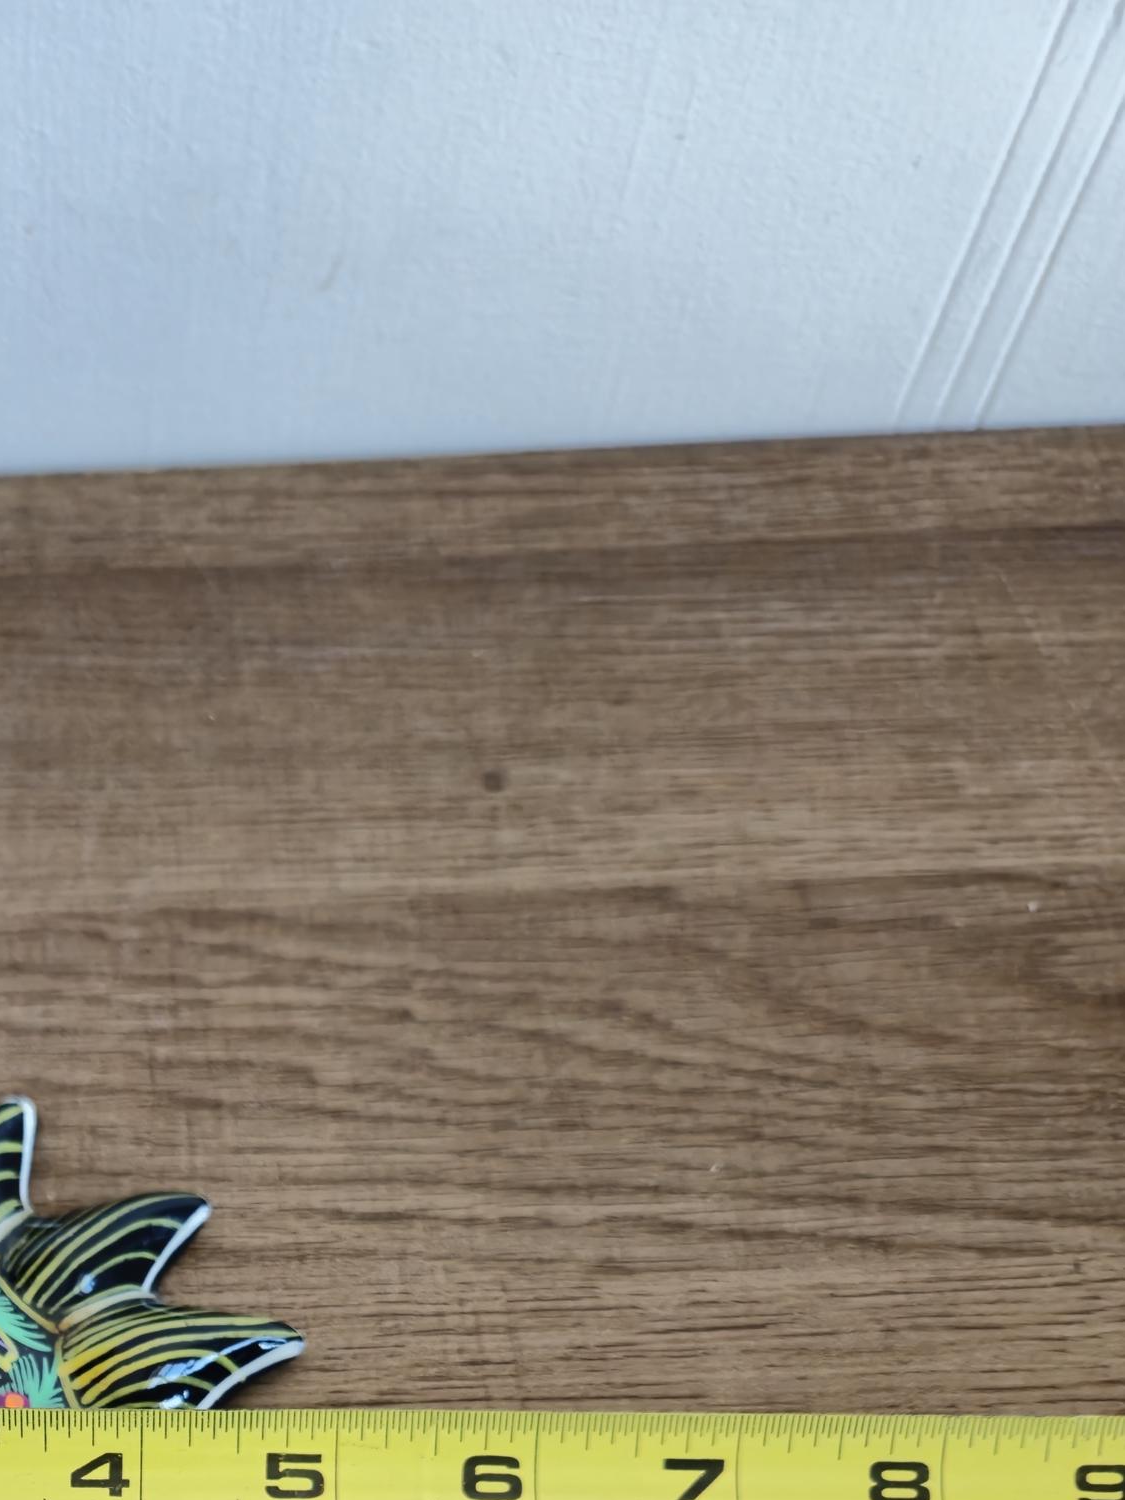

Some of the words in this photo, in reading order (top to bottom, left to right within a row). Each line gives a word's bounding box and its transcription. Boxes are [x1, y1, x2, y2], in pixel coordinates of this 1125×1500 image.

[70, 1452, 130, 1497] 4
[265, 1452, 325, 1499] 5
[462, 1455, 523, 1500] 6
